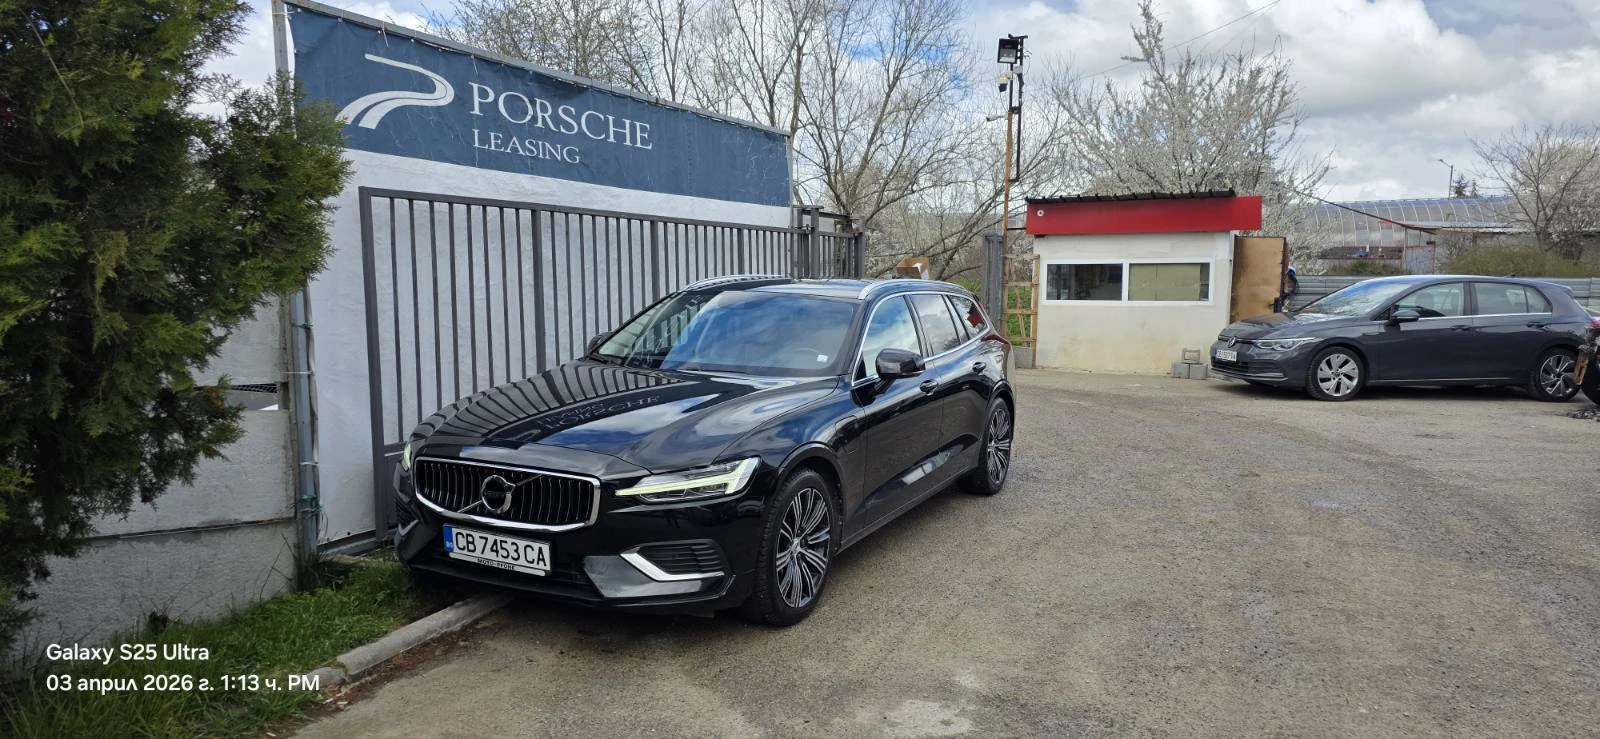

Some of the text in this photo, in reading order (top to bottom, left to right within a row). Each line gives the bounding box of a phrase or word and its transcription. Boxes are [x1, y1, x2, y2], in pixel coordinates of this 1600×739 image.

[468, 81, 652, 149] PORSCHE
[472, 128, 581, 164] LEASING
[455, 531, 547, 566] CB 7453 CA
